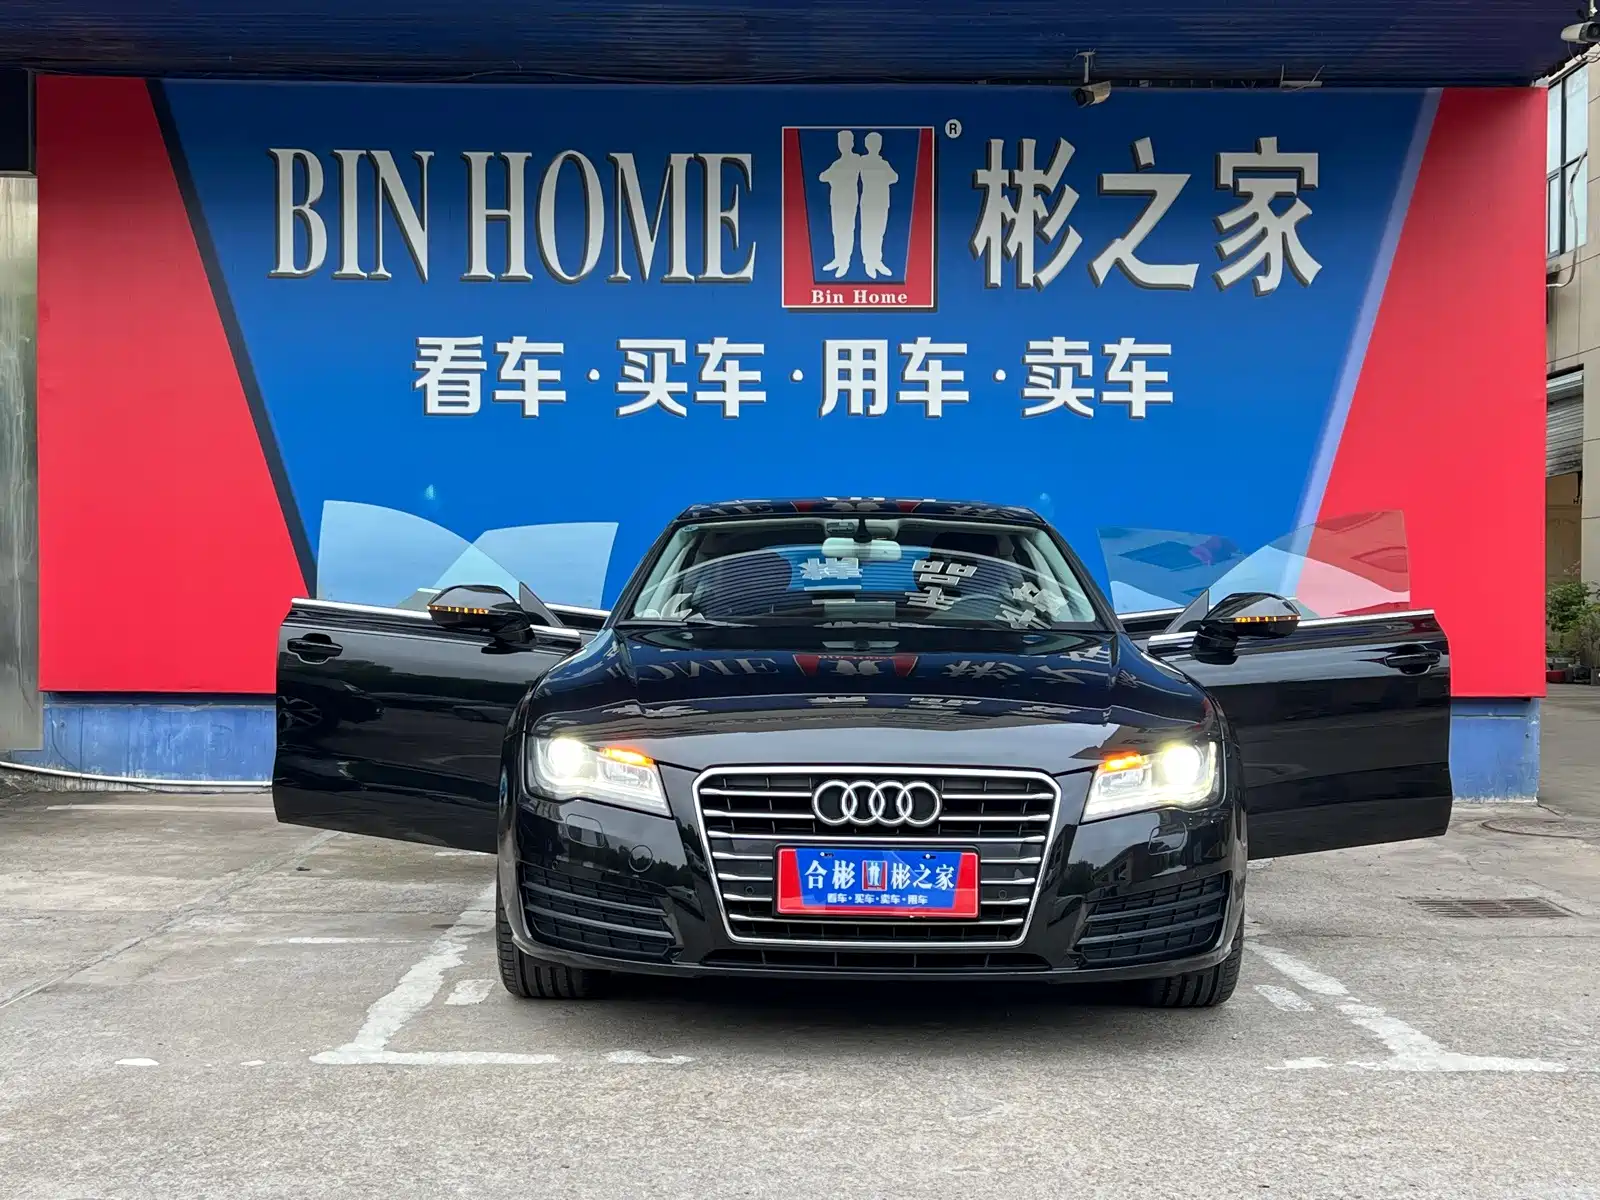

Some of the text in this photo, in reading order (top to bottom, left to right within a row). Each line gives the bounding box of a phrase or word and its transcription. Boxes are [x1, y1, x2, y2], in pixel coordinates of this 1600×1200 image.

[267, 147, 756, 283] BIN HOME
[970, 136, 1322, 296] 彬之家
[811, 289, 908, 304] Bin Home
[805, 859, 955, 890] 合彬 彬之家
